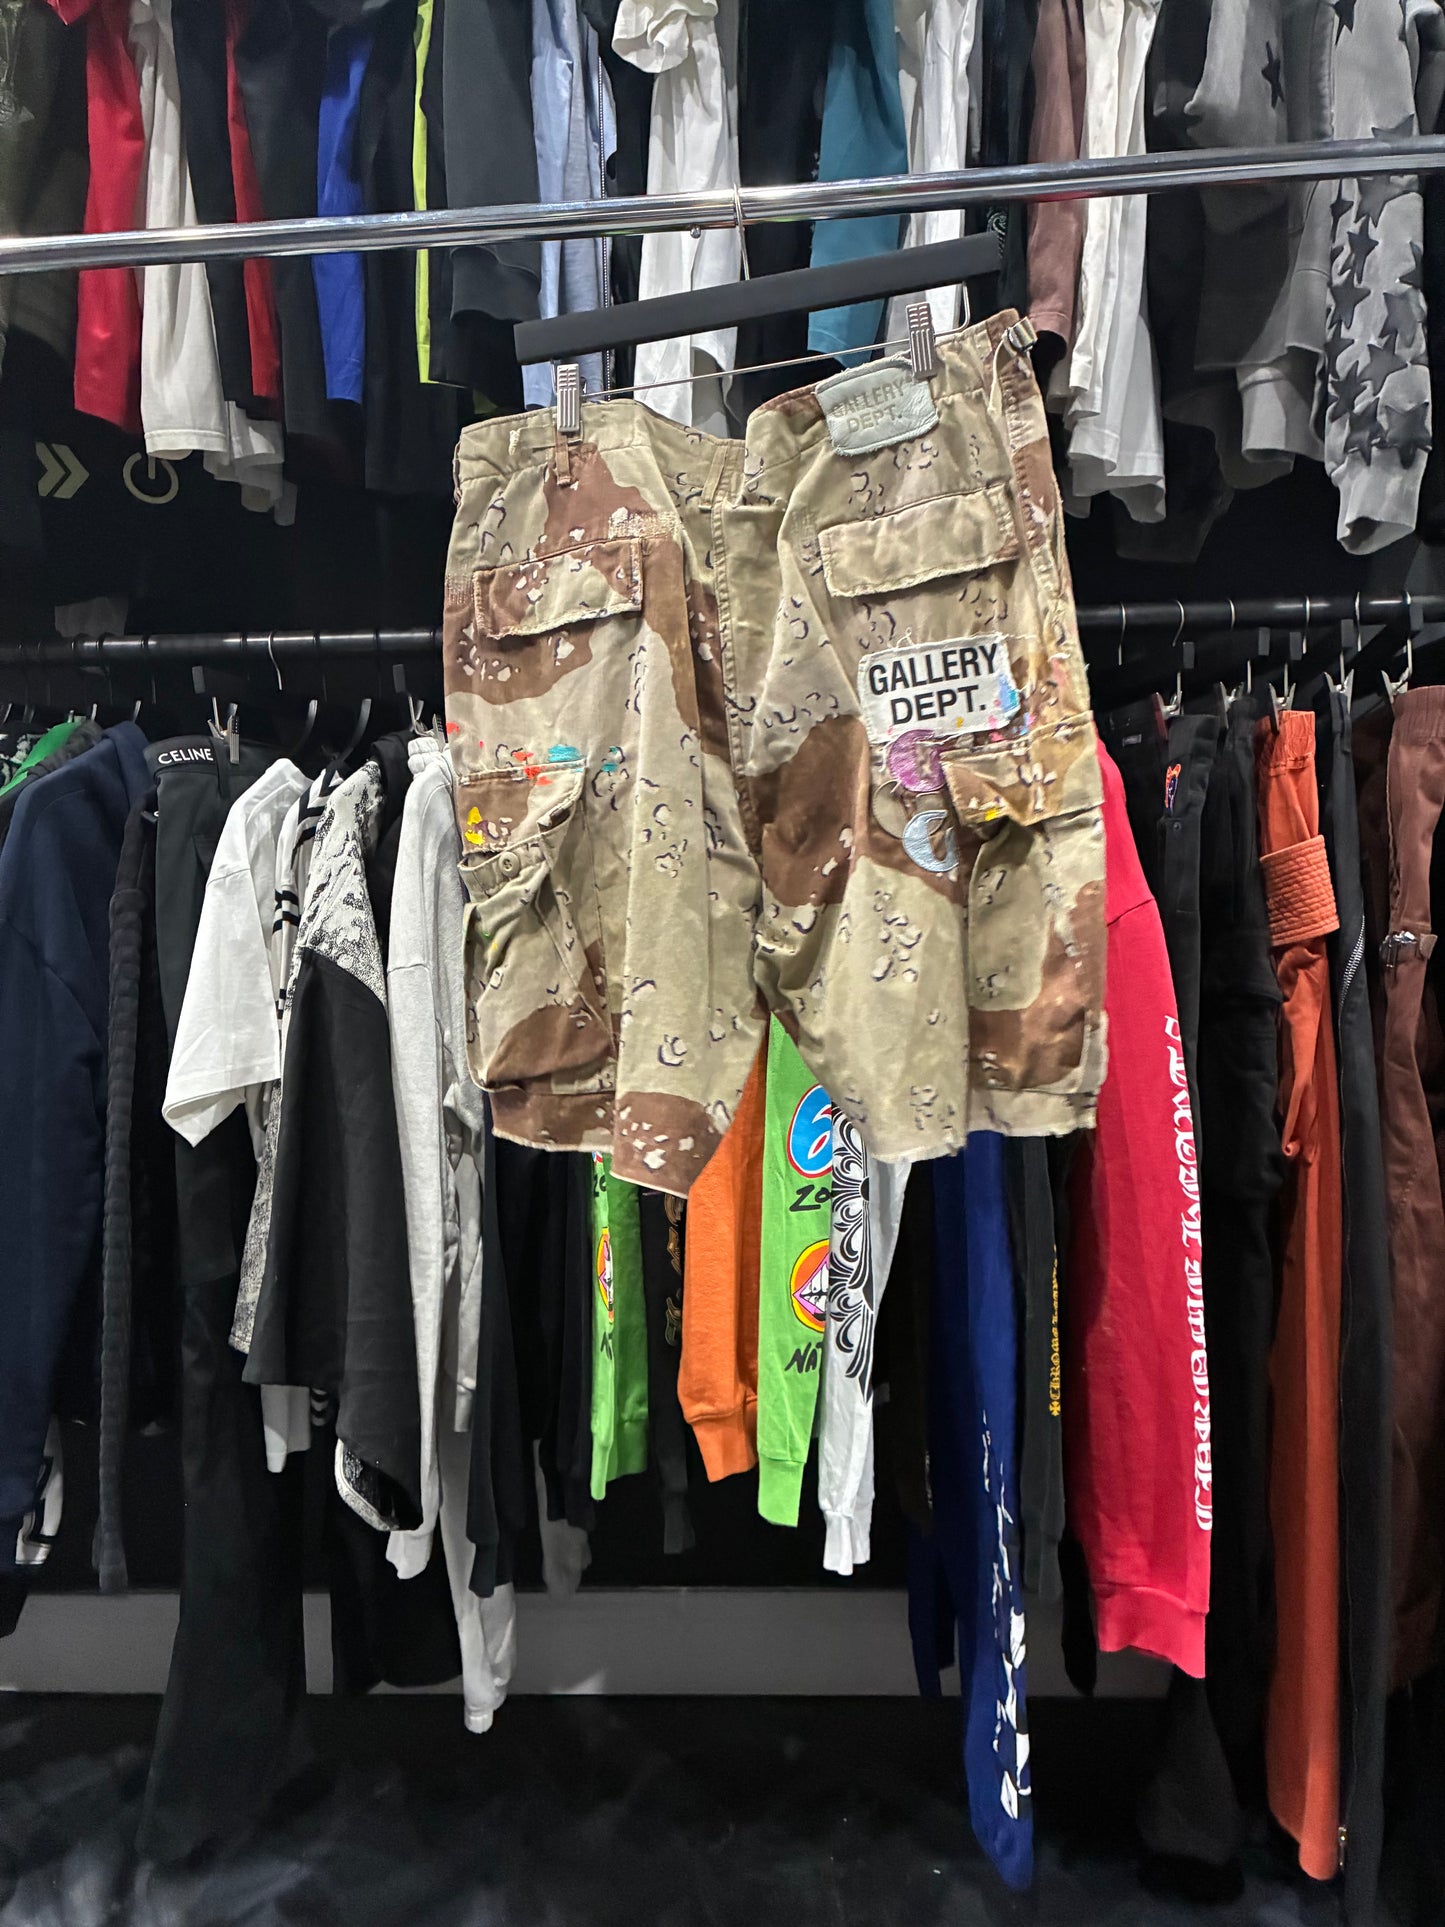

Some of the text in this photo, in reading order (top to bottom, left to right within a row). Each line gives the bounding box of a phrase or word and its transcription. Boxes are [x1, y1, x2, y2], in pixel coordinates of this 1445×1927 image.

[847, 404, 903, 433] DEPT.
[869, 643, 998, 696] GALLERY
[890, 684, 987, 726] DEPT.
[157, 747, 214, 765] CELINE
